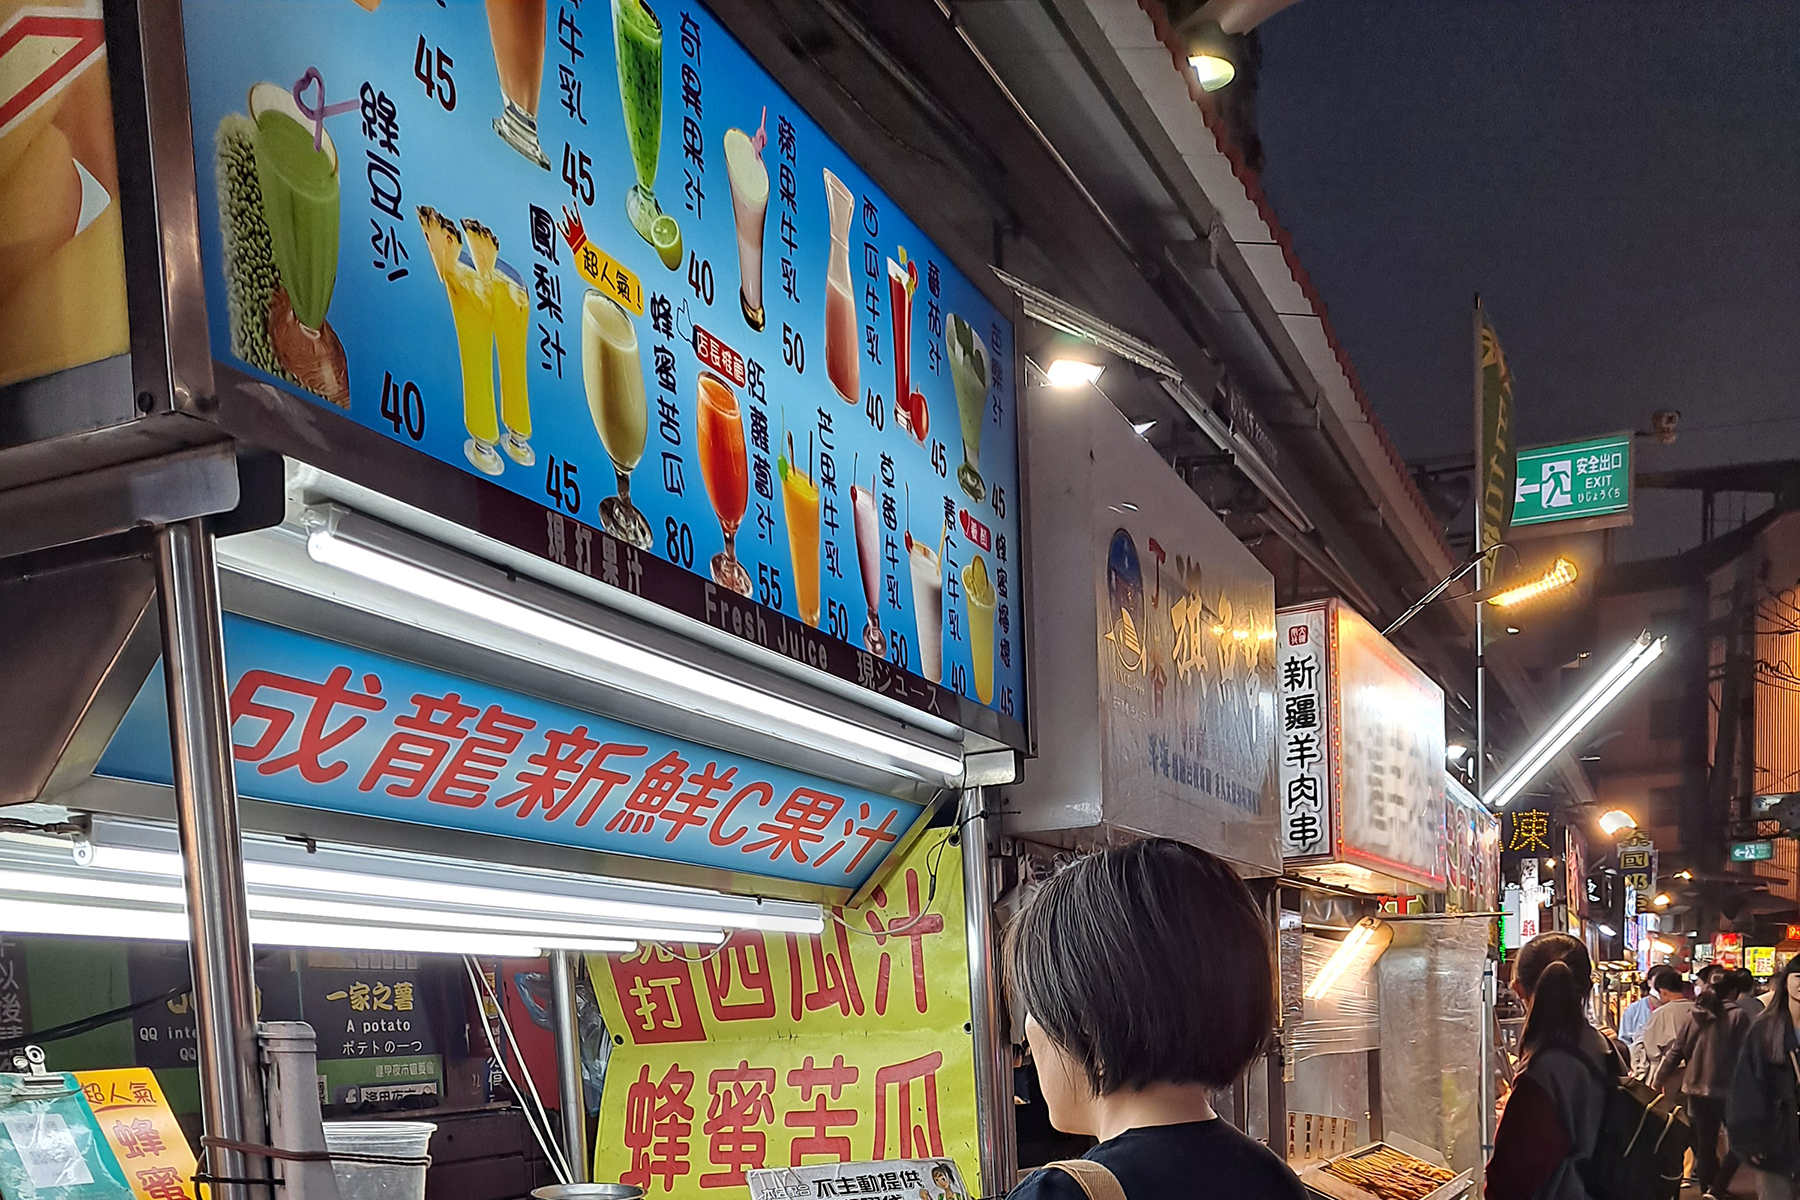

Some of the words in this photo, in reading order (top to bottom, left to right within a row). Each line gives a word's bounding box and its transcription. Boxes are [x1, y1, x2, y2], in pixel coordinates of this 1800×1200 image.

[413, 33, 456, 112] 45
[680, 10, 705, 220] 奇異果汁
[358, 82, 410, 283] 綠豆沙
[562, 141, 595, 207] 45
[528, 202, 566, 380] 鳳梨汁
[688, 250, 714, 306] 40
[863, 195, 882, 366] 西瓜牛乳
[697, 331, 745, 384] 店長推薦
[783, 322, 805, 374] 50
[381, 370, 424, 441] 40
[651, 291, 684, 497] 蜂蜜苦瓜
[866, 388, 884, 432] 40
[747, 357, 776, 545] 紅蘿蔔汁
[931, 437, 948, 478] 45
[1576, 453, 1622, 476] 安全出口
[546, 454, 581, 514] 45
[817, 406, 843, 579] 芒果牛乳
[991, 483, 1005, 520] 45
[1585, 475, 1613, 489] EXIT
[547, 511, 643, 595] 現打果汁
[665, 516, 694, 569] 80
[879, 451, 902, 610] 草莓牛乳
[758, 562, 783, 610] 55
[943, 495, 962, 641] 薏仁牛乳
[704, 582, 768, 646] Fresh
[776, 616, 829, 671] Juice
[828, 598, 848, 643] 50
[890, 629, 908, 669] 50
[856, 654, 941, 714] 現ジュース
[951, 661, 966, 697] 40
[1000, 686, 1014, 717] 45
[229, 665, 898, 875] 成龍新鮮C果汁
[1284, 655, 1319, 848] 新疆羊肉串
[700, 868, 944, 1022] 西瓜汁
[326, 981, 414, 1011] 一家之薯
[140, 1027, 158, 1041] QQ
[342, 1040, 423, 1055] ポテトの一つ
[346, 1019, 355, 1033] A
[363, 1018, 411, 1034] potato
[80, 1081, 157, 1106] 超人氣
[620, 1050, 945, 1193] 蜂蜜苦瓜
[812, 1170, 924, 1200] 不主動提供
